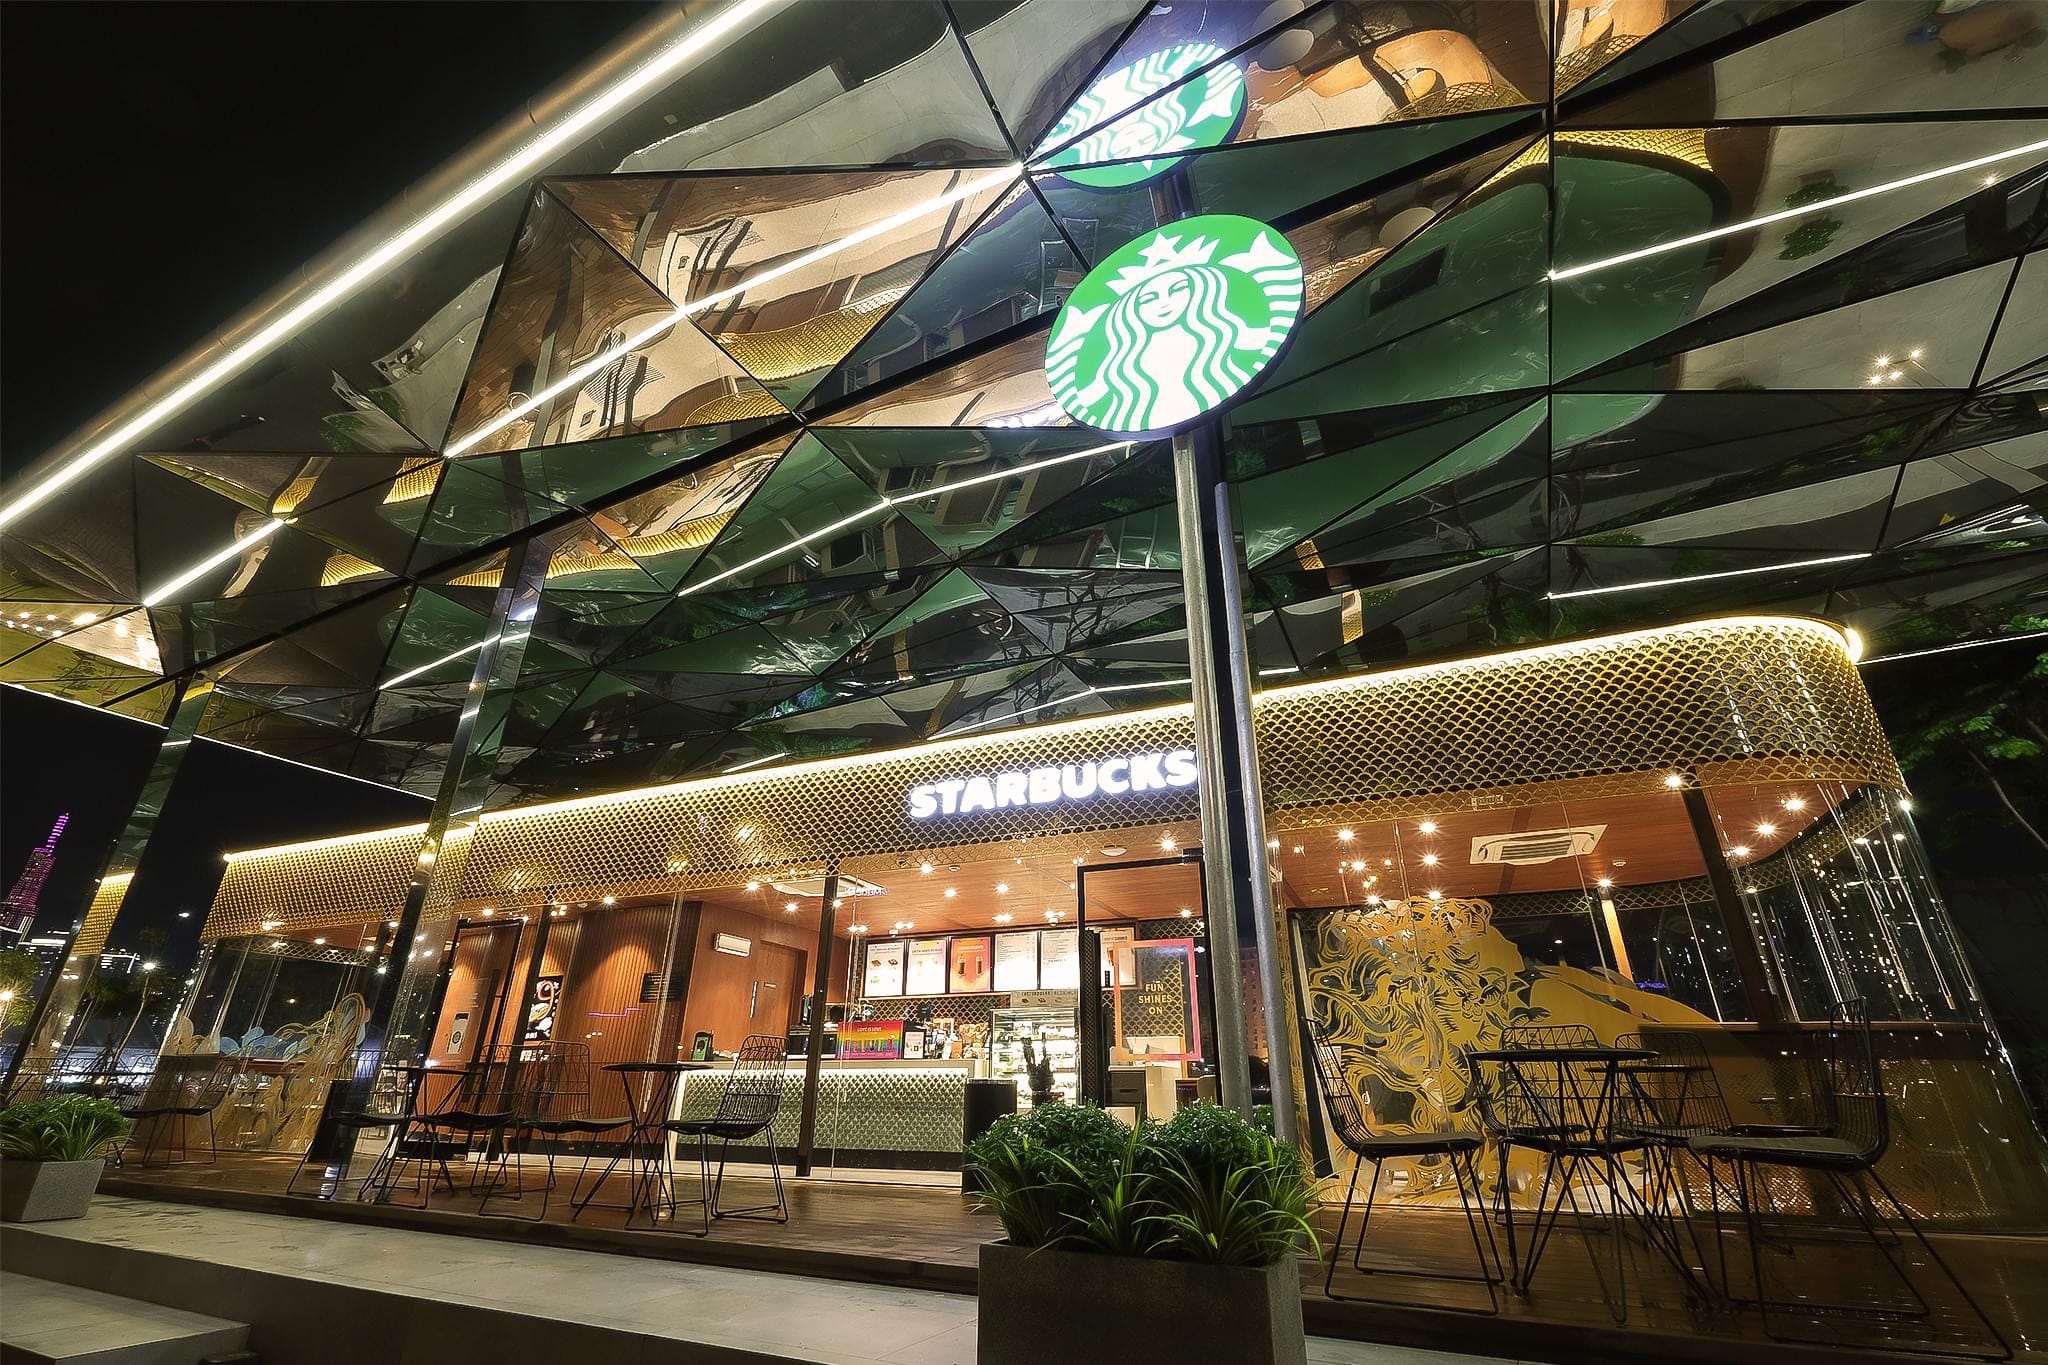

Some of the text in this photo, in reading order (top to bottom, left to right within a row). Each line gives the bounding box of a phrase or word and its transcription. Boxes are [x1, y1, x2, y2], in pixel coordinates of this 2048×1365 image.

[909, 750, 1197, 818] STARBUCKS
[1145, 983, 1164, 992] FUN
[1138, 994, 1172, 1004] SHINES
[1148, 1006, 1163, 1015] ON
